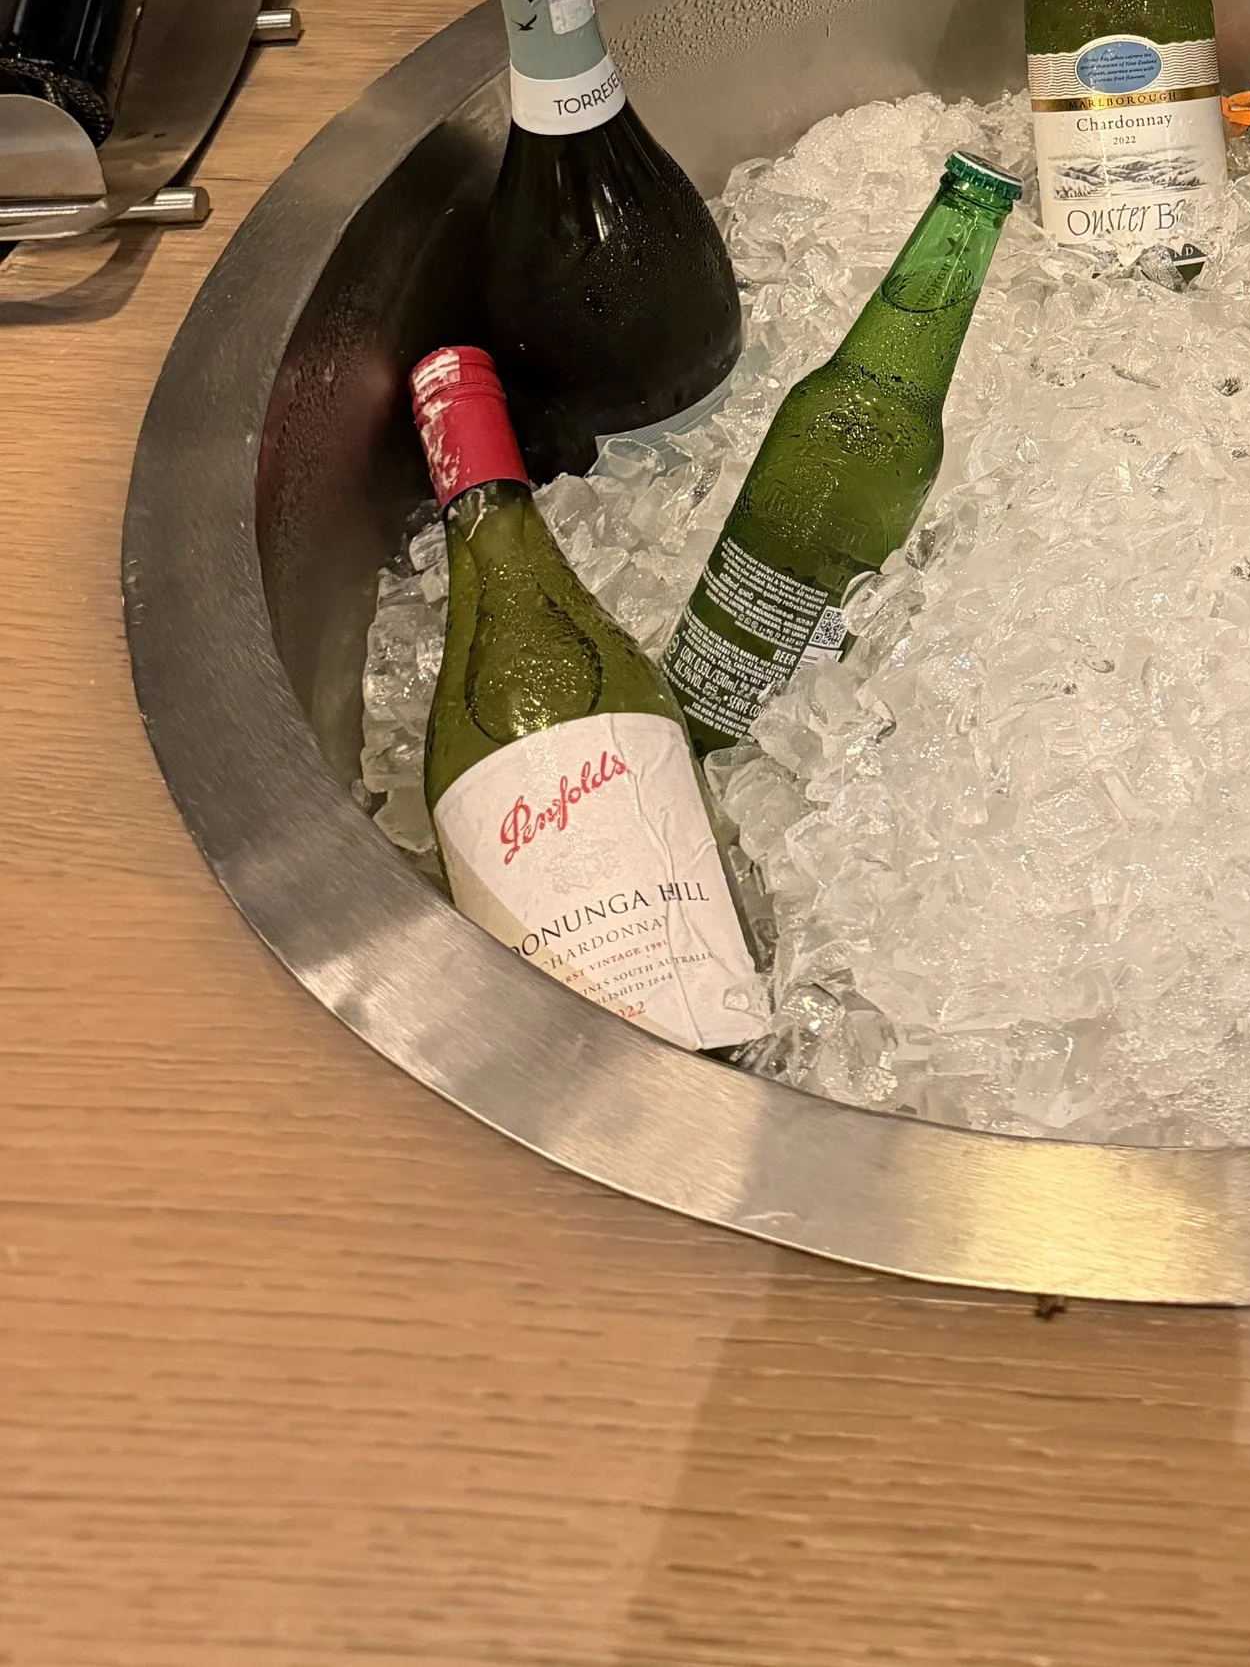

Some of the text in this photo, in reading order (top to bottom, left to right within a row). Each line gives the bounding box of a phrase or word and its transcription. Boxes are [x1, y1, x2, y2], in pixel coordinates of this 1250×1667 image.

[1068, 91, 1177, 110] MARLBOROUGH
[1076, 114, 1173, 133] Chardonnay
[1113, 135, 1137, 145] 2022
[1067, 203, 1151, 236] Oyster
[771, 648, 798, 667] BEER
[724, 693, 752, 714] SERVE
[499, 750, 628, 865] Penfolds
[656, 881, 710, 903] HILL
[588, 947, 642, 972] VINTAGE
[612, 964, 654, 985] SOUTH
